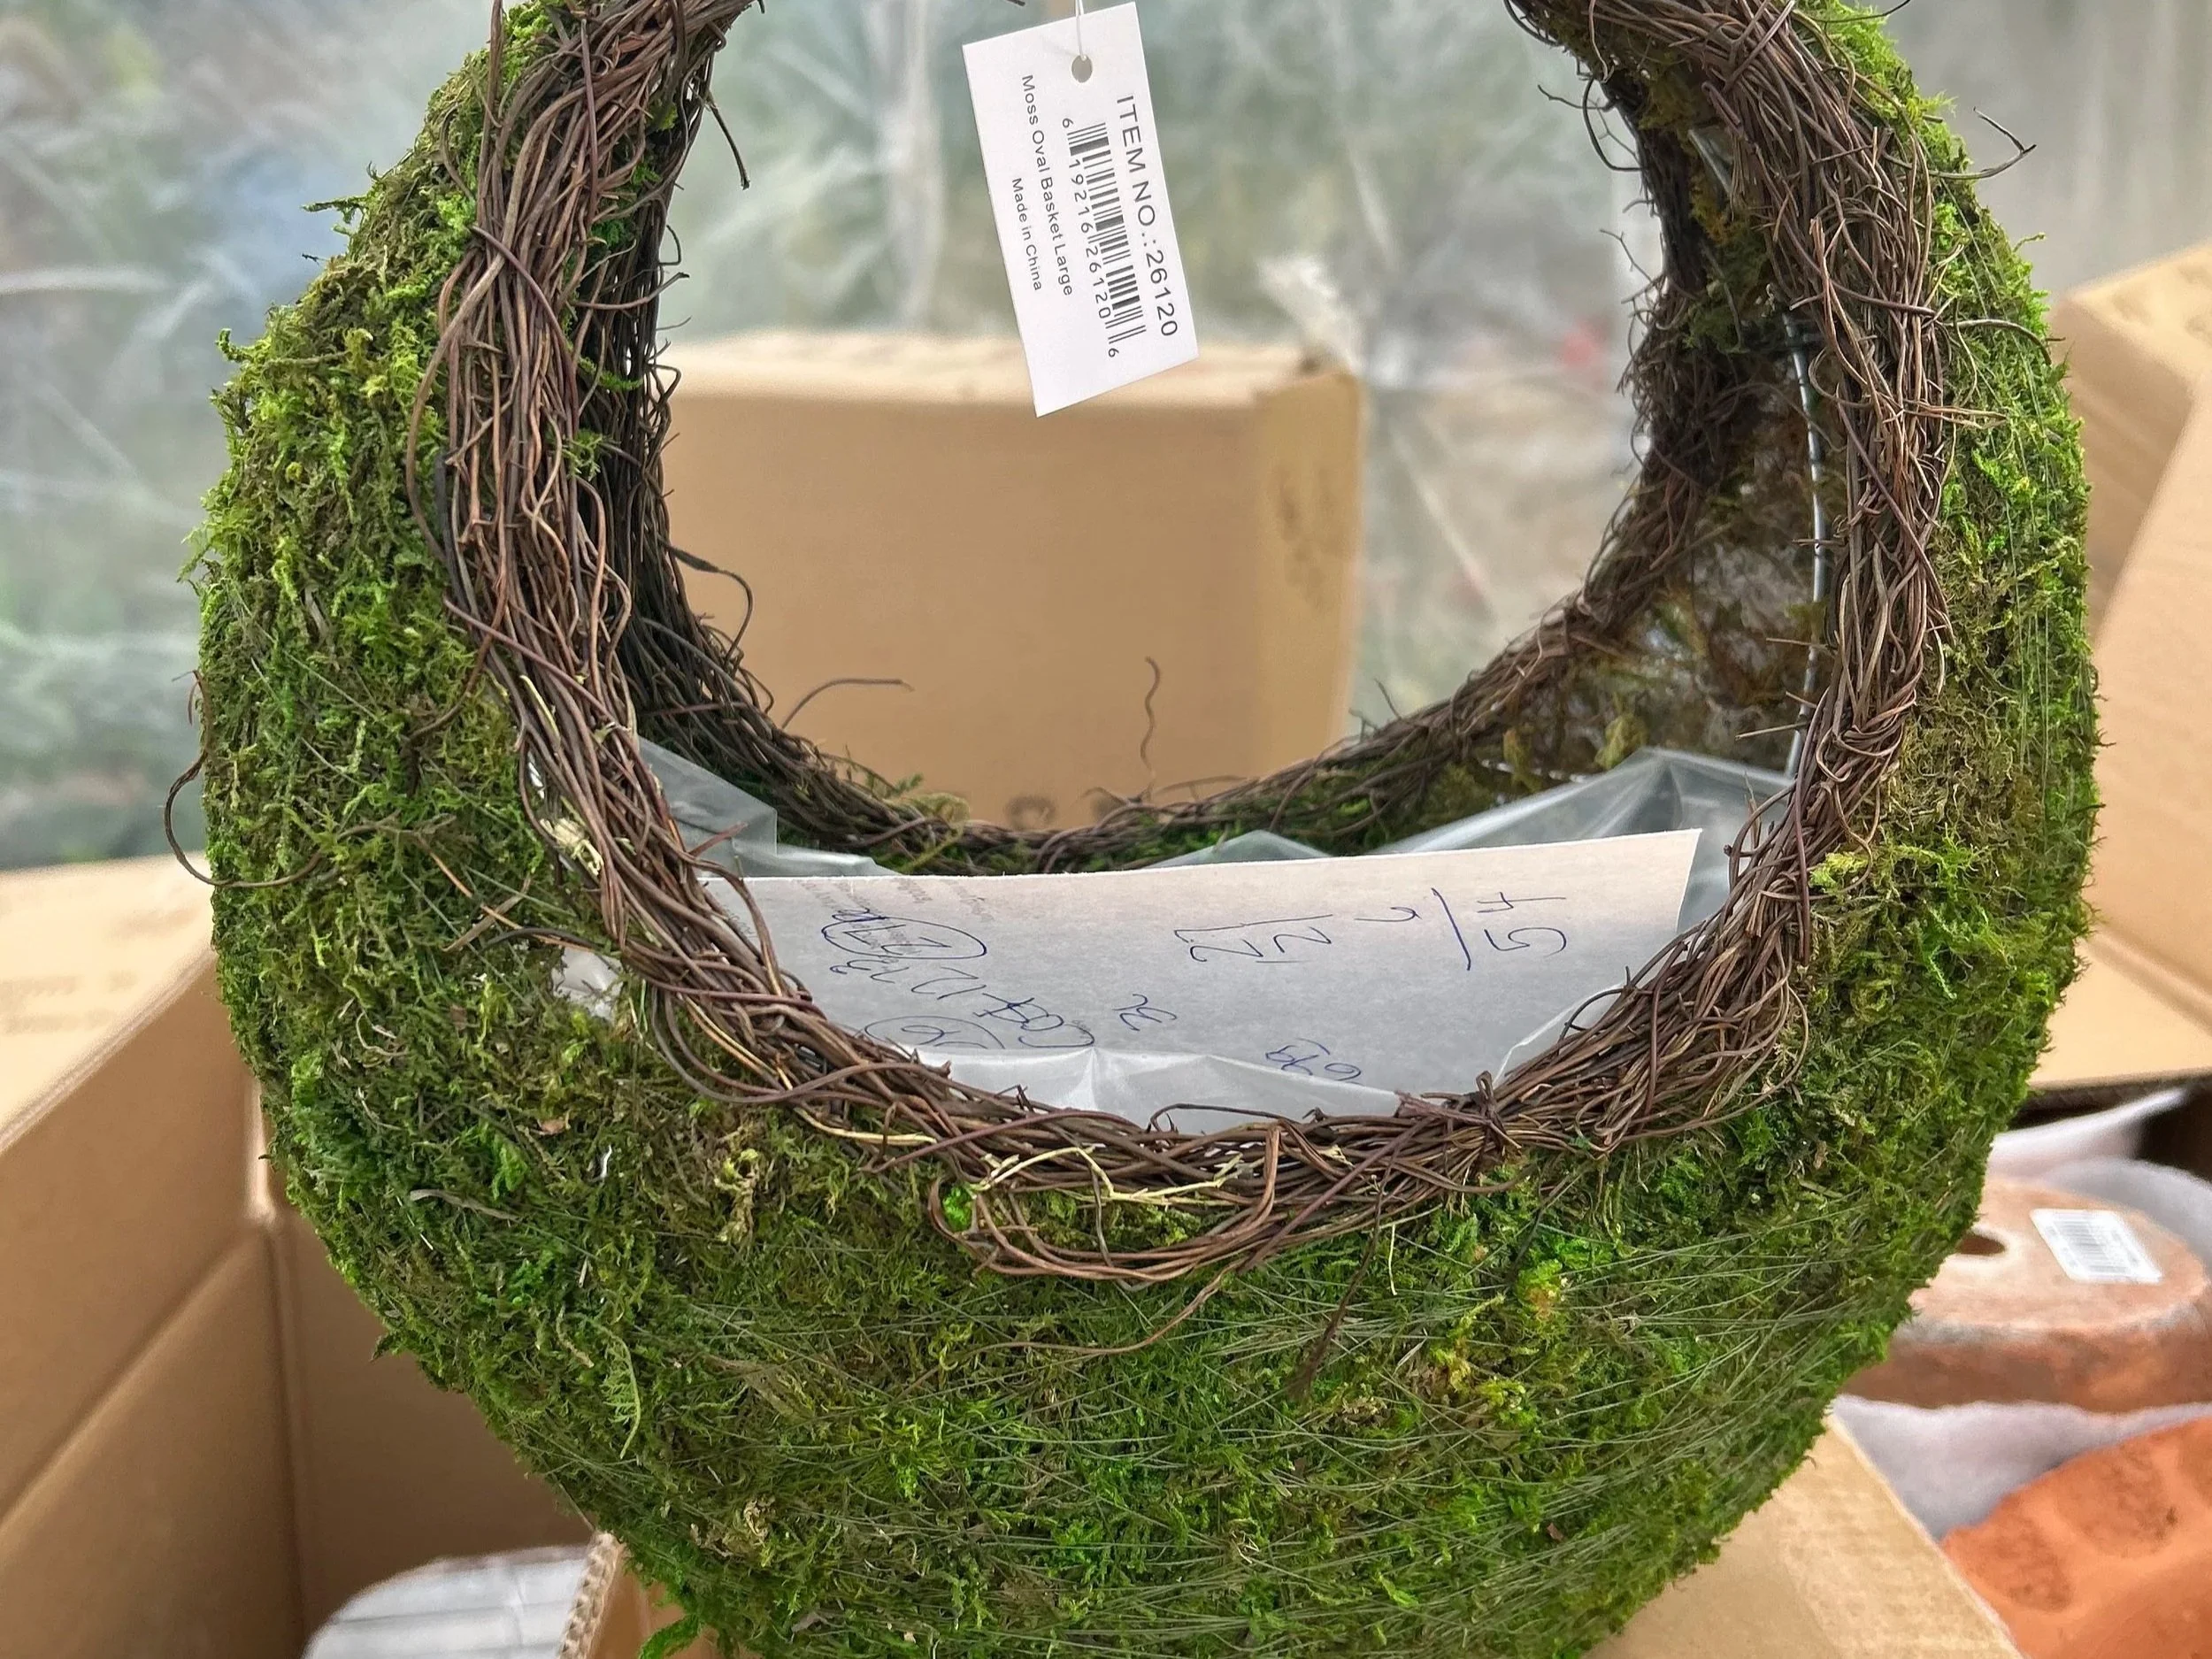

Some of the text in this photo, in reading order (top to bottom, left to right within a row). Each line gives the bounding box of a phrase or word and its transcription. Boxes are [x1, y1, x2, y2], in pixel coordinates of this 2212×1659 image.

[1022, 75, 1072, 296] Moss Oval Basket Large
[1117, 95, 1146, 173] ITEM
[1012, 178, 1041, 291] Made in China
[1062, 118, 1119, 357] 6 19216 26120 6
